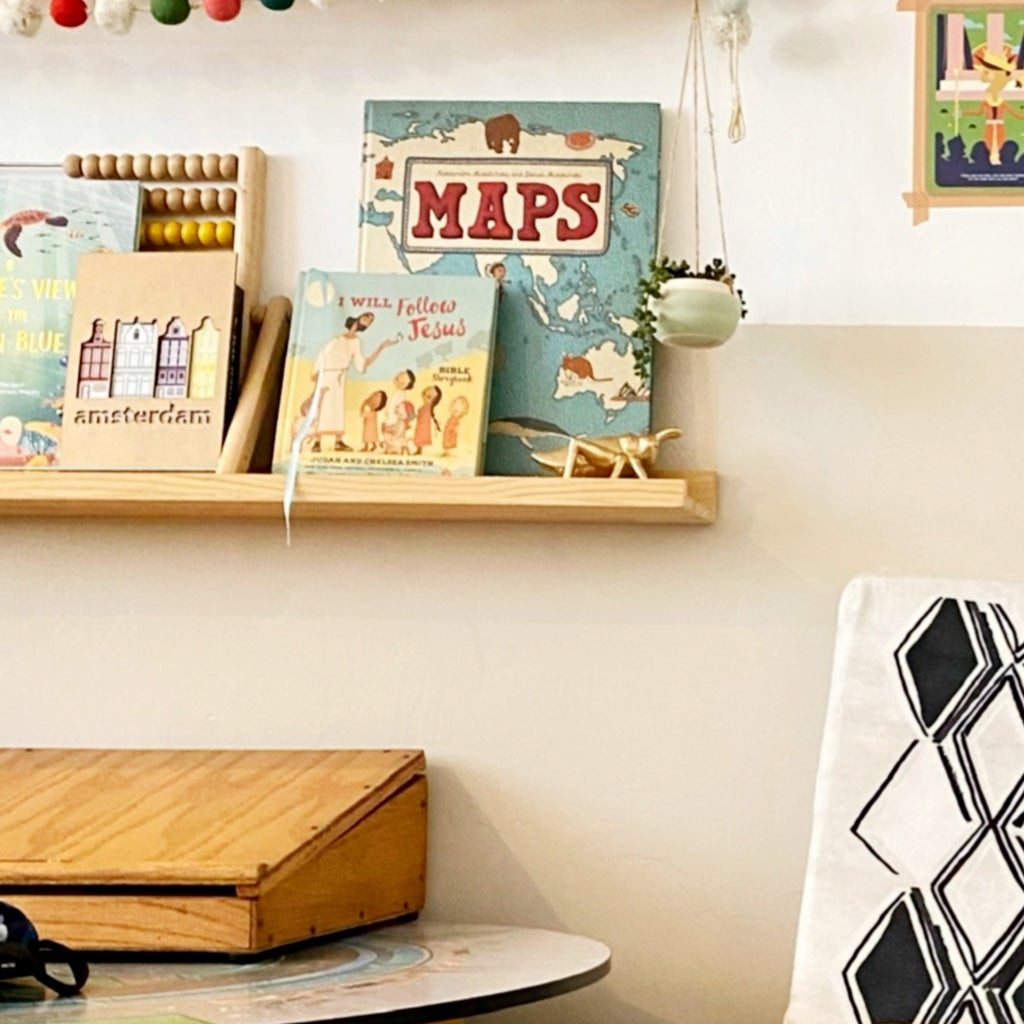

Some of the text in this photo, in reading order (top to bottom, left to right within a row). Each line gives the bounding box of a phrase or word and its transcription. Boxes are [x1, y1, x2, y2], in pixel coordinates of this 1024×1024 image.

[412, 181, 601, 241] MAPS
[338, 295, 457, 316] I WILL Follow
[408, 317, 466, 341] Jesus
[16, 330, 66, 354] BLUE
[438, 366, 471, 375] BIBLE
[73, 403, 211, 425] amsterdam
